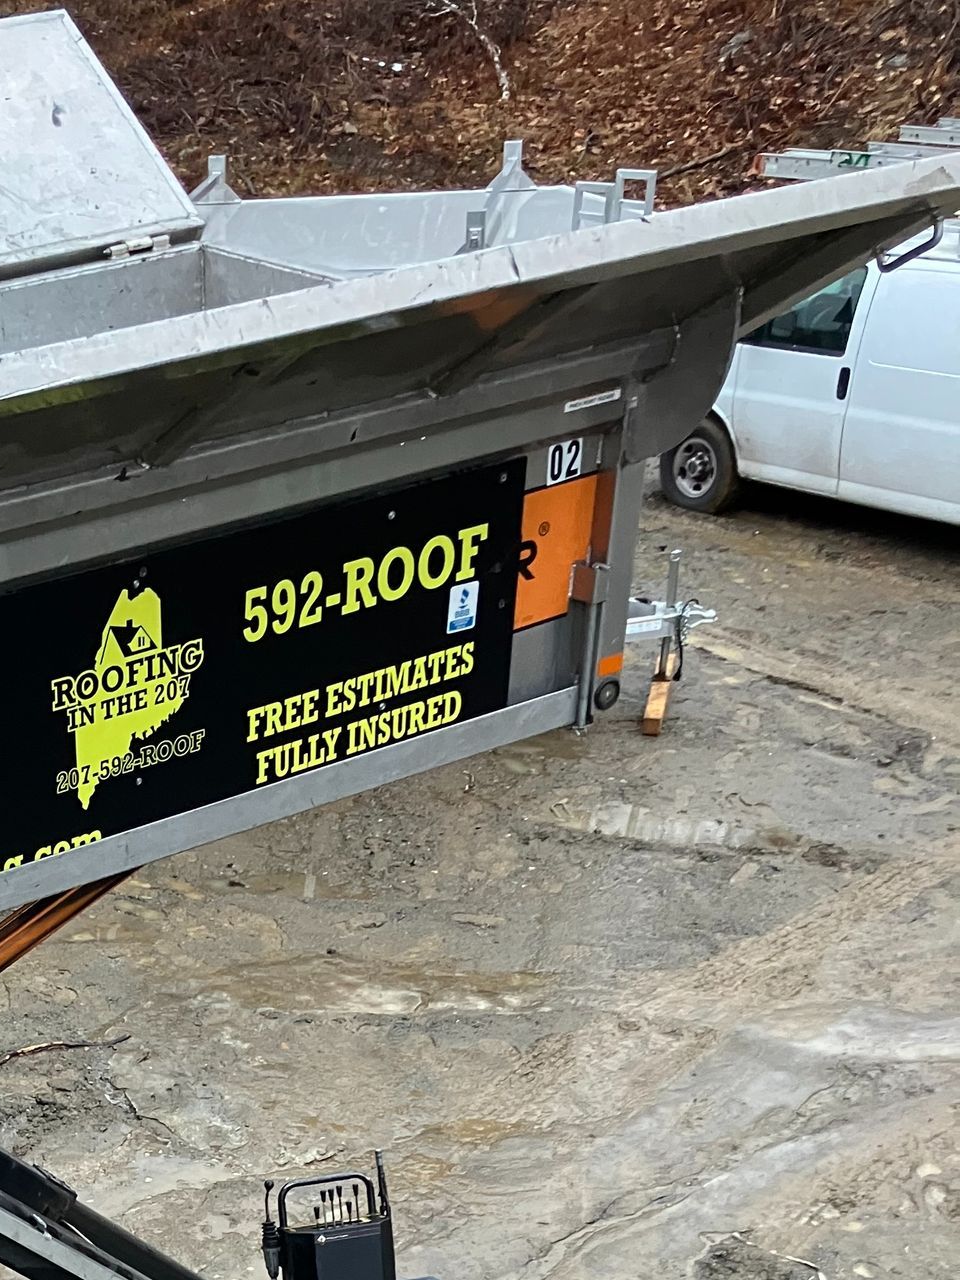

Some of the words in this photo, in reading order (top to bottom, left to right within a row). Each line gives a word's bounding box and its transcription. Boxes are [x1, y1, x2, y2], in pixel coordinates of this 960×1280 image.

[550, 439, 580, 481] 02
[243, 523, 489, 642] 592-ROOF
[51, 638, 204, 712] ROOFING
[67, 704, 96, 732] IN
[101, 688, 148, 720] THE
[154, 674, 192, 704] 207
[246, 689, 319, 743] FREE
[325, 641, 475, 718] ESTIMATES
[56, 729, 205, 794] 207-592-ROOF
[256, 727, 342, 785] FULLY
[346, 690, 463, 755] INSURED
